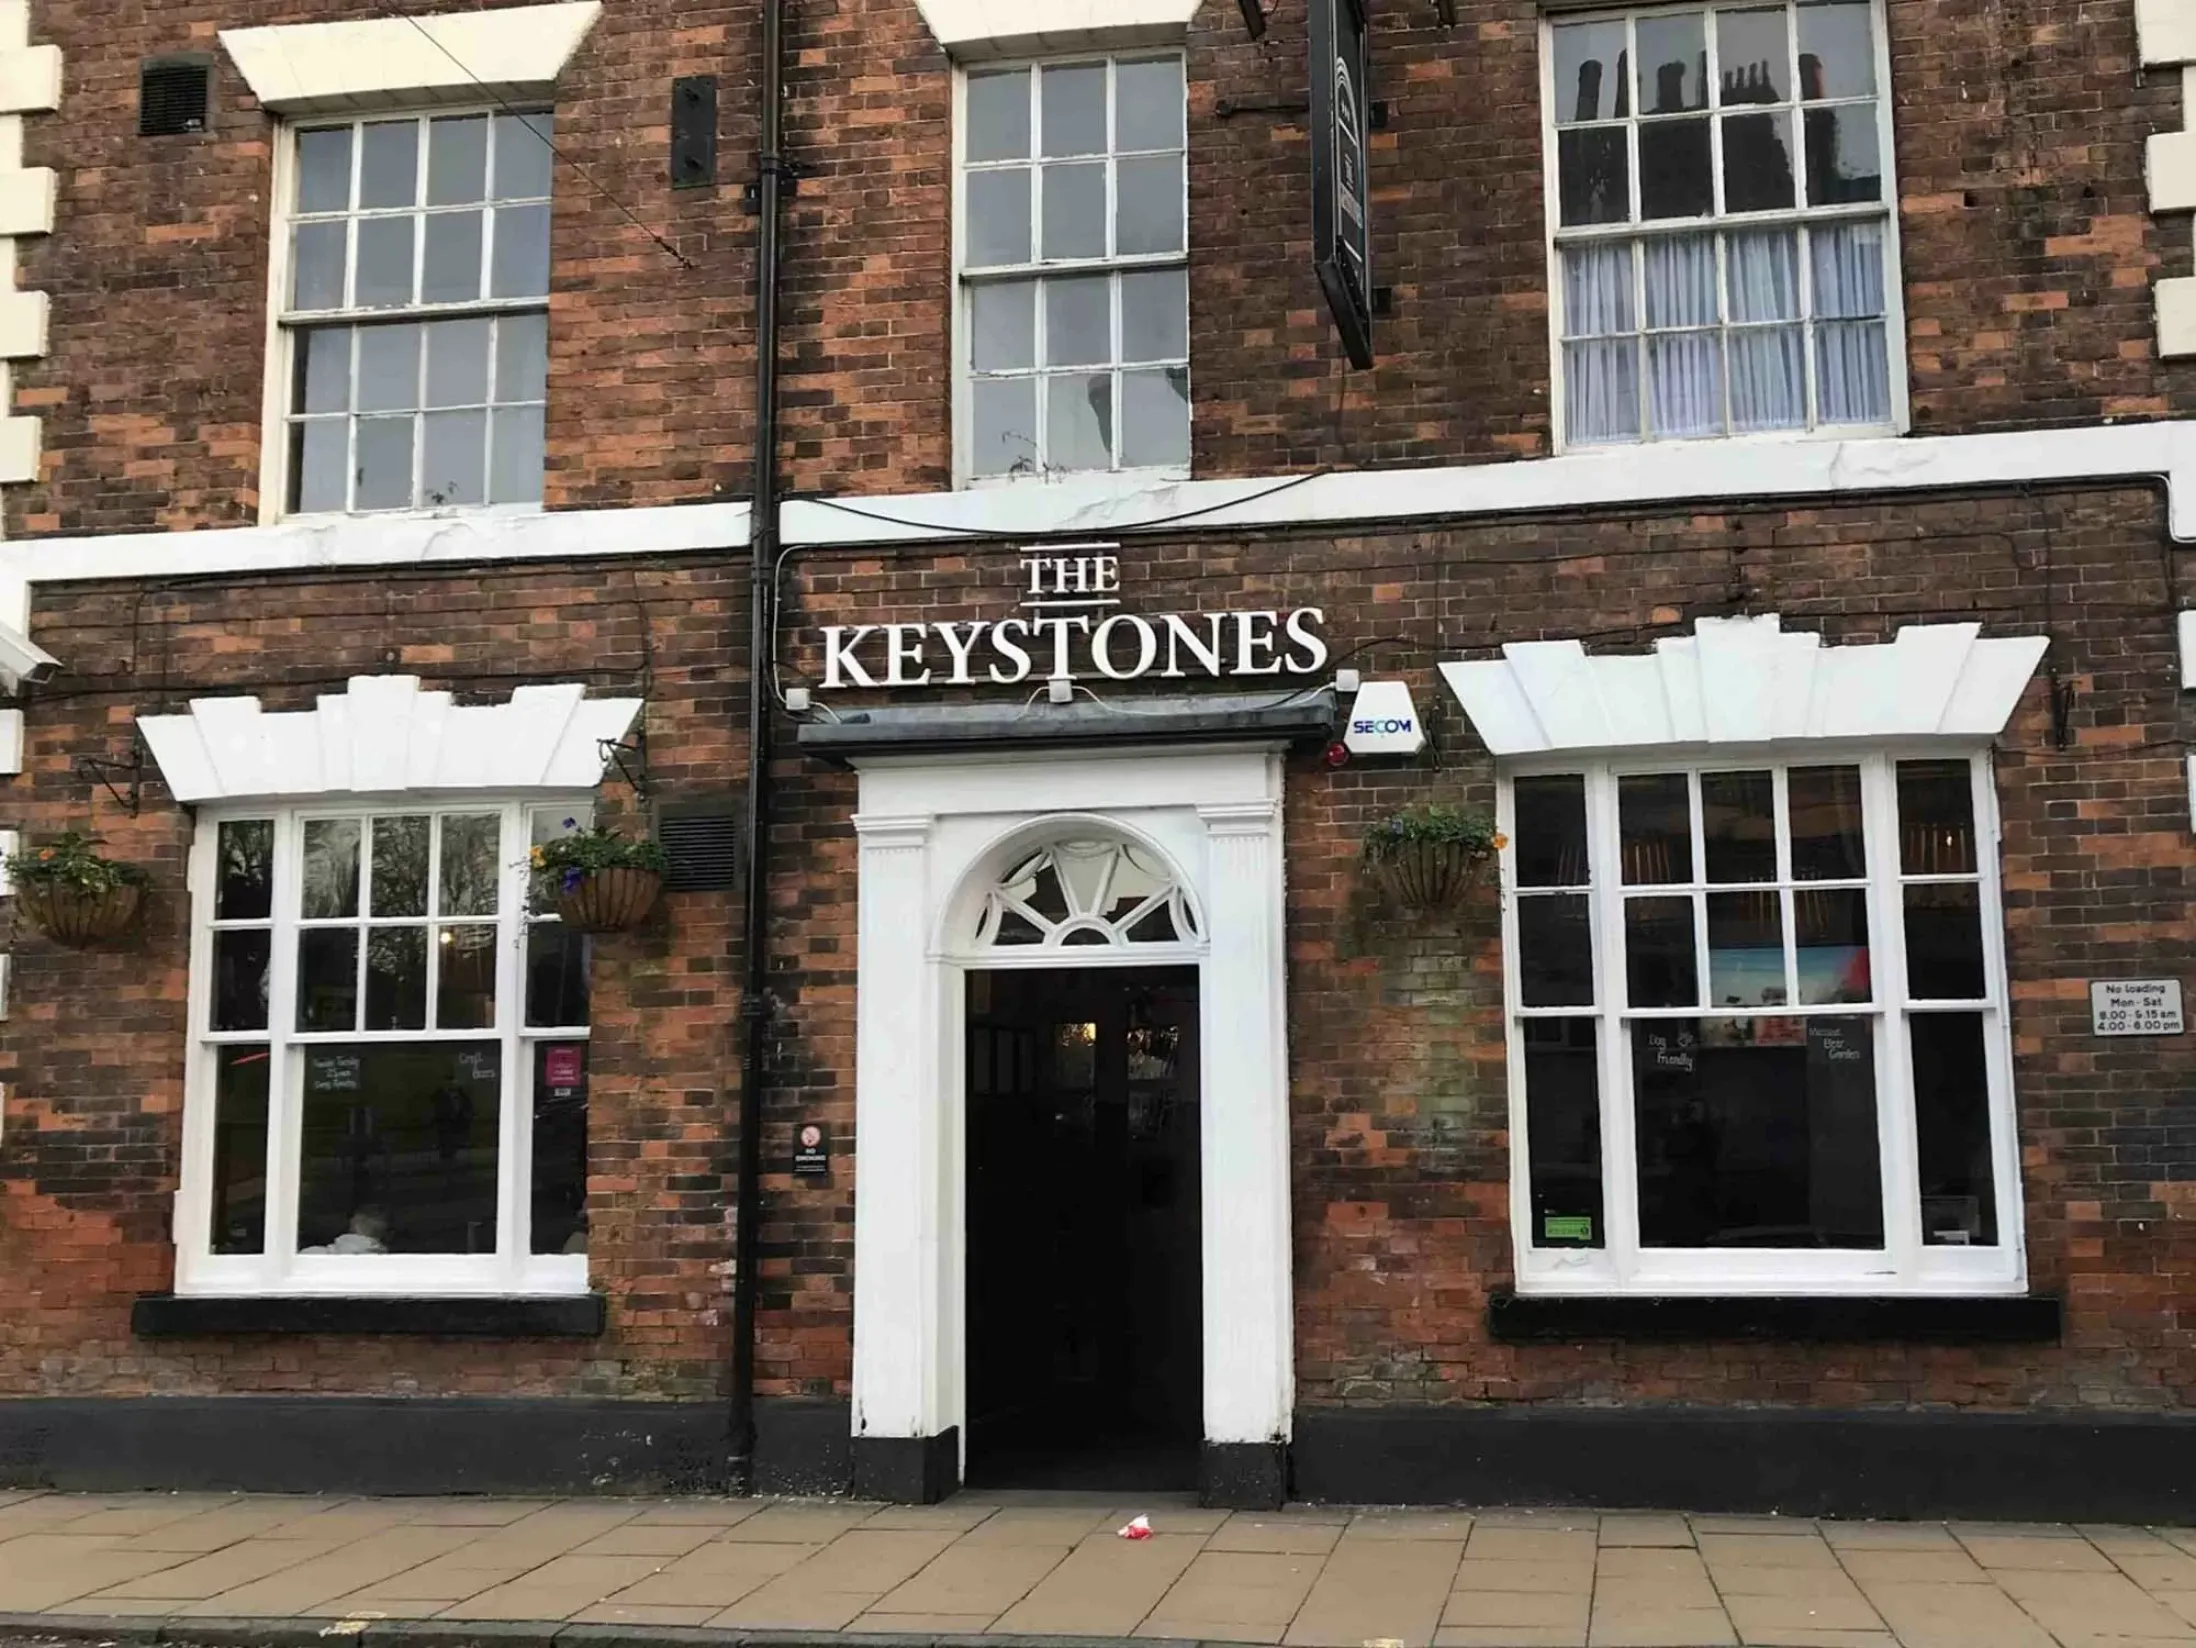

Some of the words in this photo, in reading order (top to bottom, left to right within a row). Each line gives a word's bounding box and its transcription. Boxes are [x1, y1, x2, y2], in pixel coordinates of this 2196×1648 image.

[1020, 555, 1120, 595] THE
[817, 606, 1329, 690] KEYSTONES
[1353, 719, 1412, 734] SECOM
[2106, 984, 2122, 994] No
[2125, 983, 2166, 994] loading
[2110, 998, 2134, 1007] Mon
[2143, 997, 2162, 1007] Sat
[2163, 1022, 2180, 1031] pm
